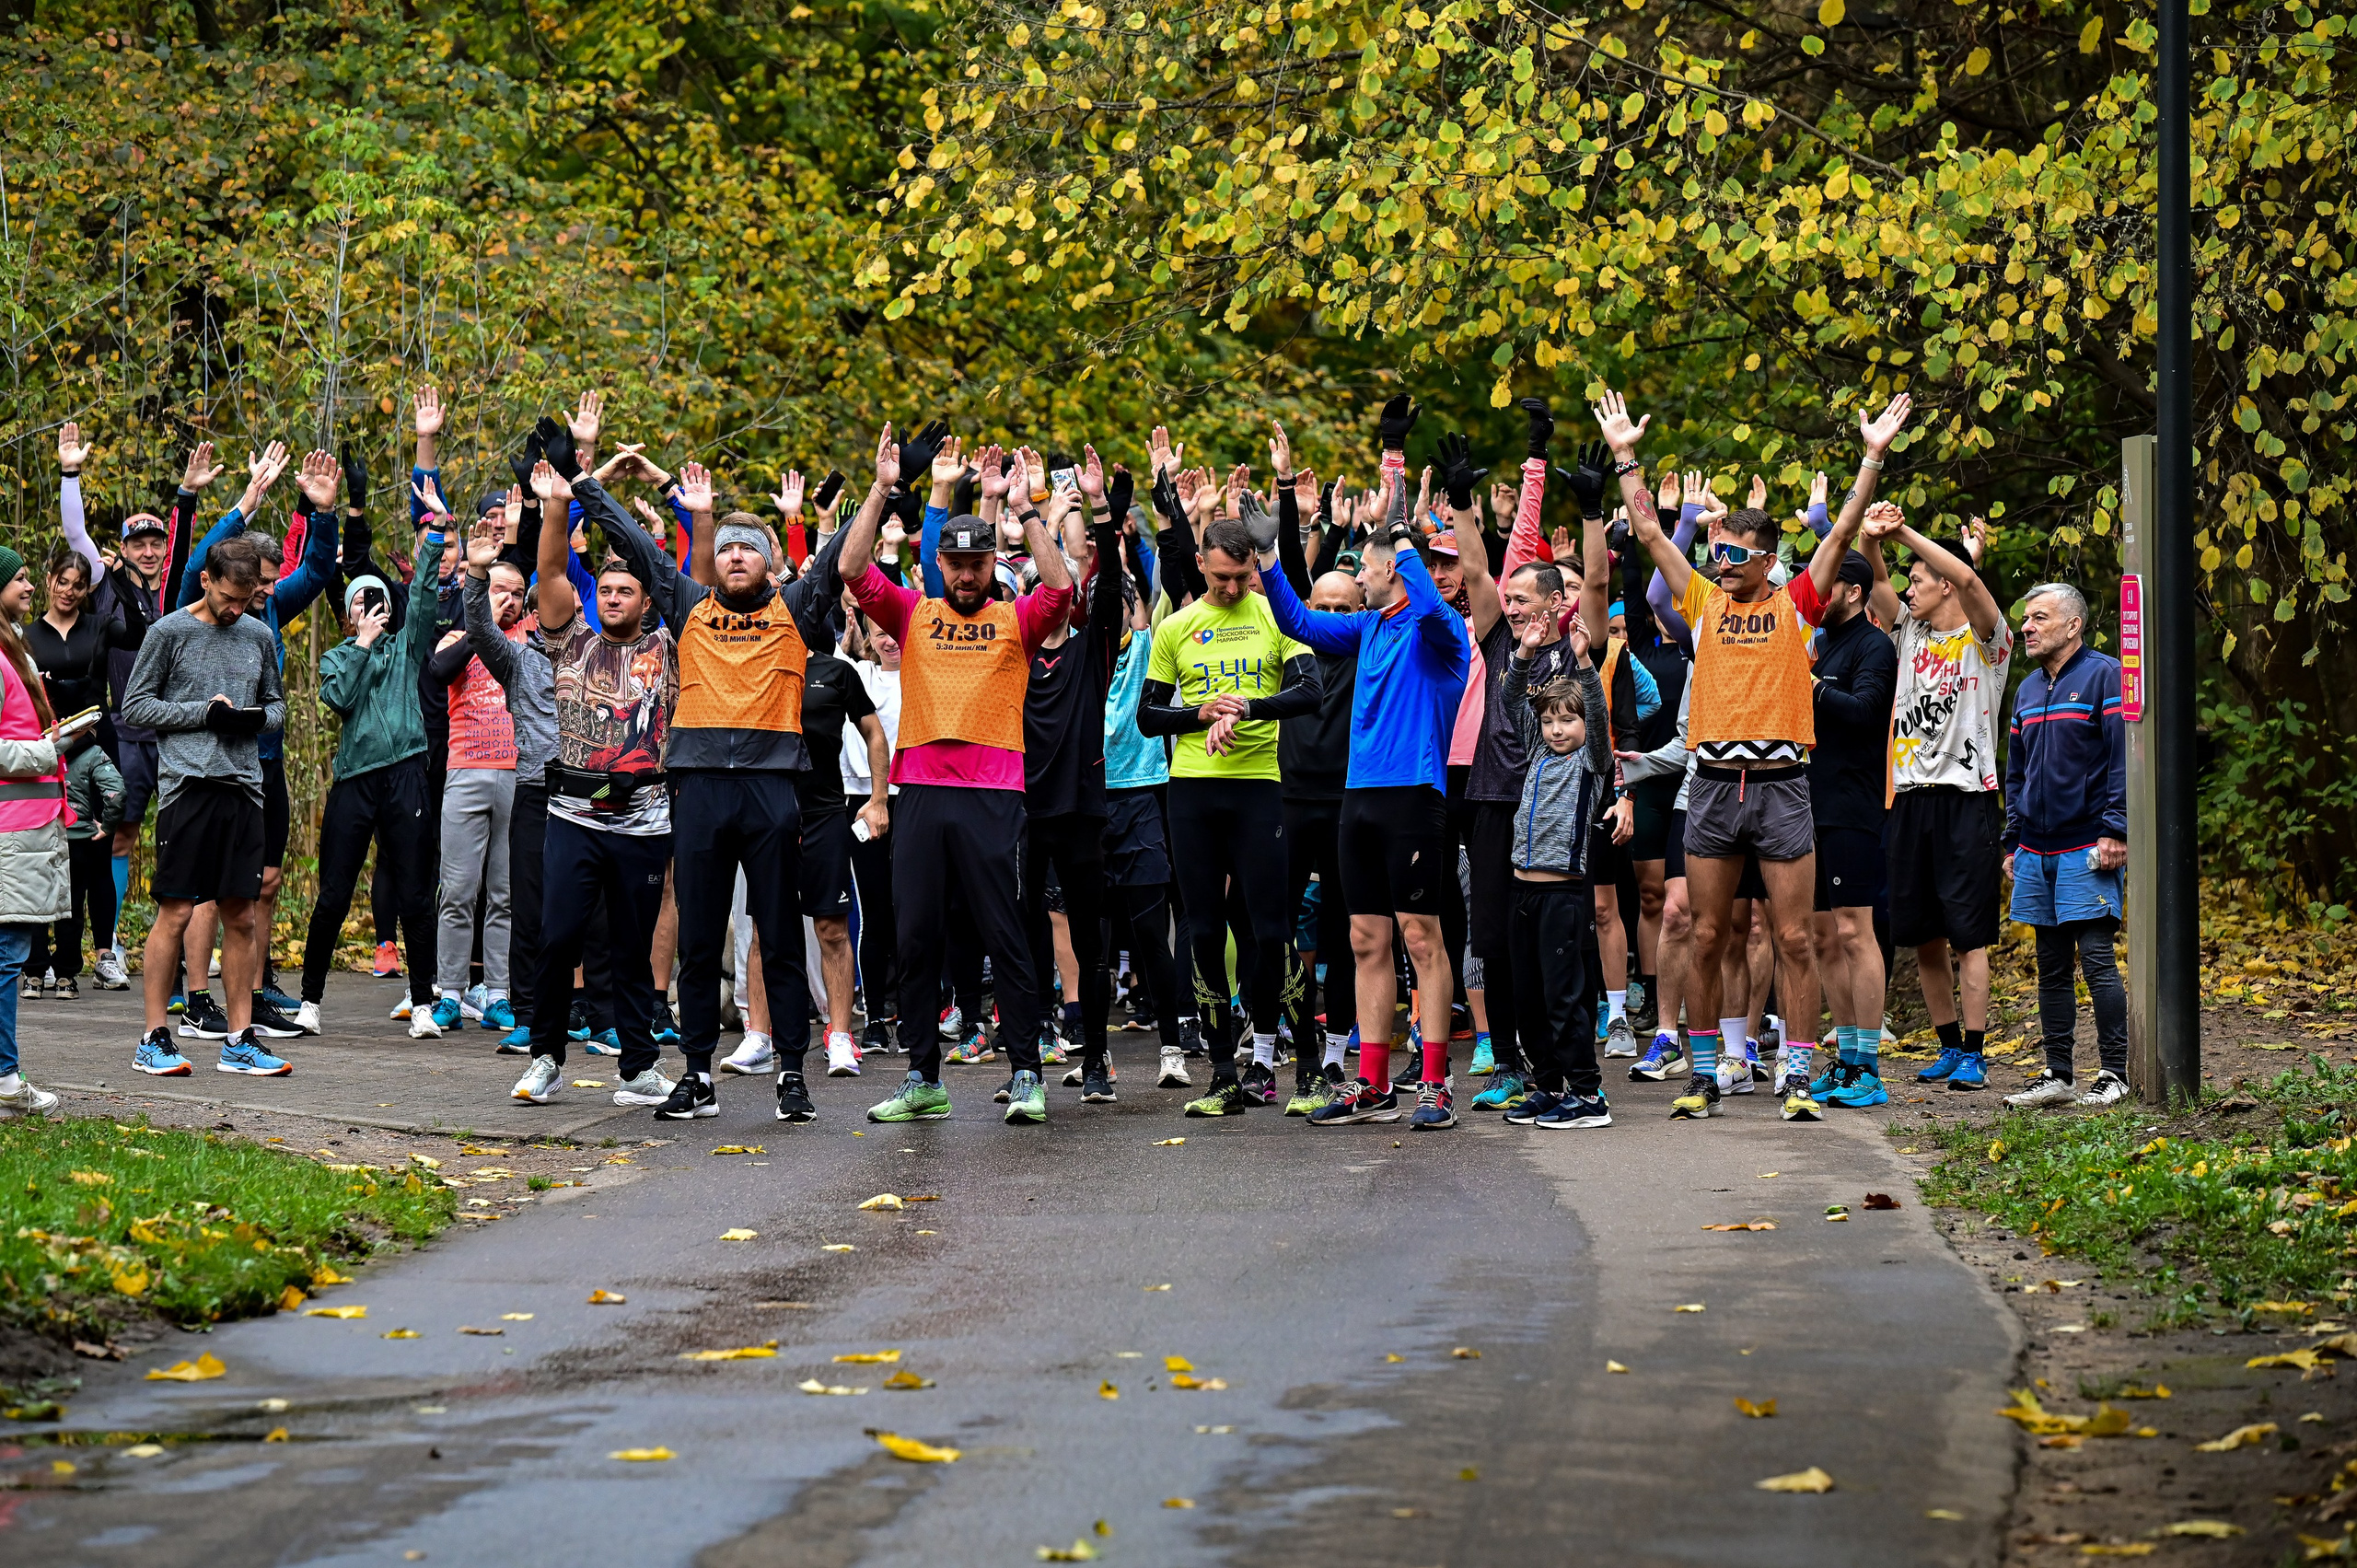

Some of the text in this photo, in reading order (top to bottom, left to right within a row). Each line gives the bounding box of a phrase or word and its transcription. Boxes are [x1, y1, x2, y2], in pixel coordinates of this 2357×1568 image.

[1716, 611, 1777, 635] 20:00
[929, 617, 996, 642] 27:30
[1216, 630, 1260, 638] МОСКОВСКИЙ
[1216, 635, 1248, 644] МАРАФОН
[1721, 636, 1736, 645] 4:00
[935, 643, 954, 651] 5:30
[1192, 657, 1262, 695] 3:44
[648, 874, 662, 882] EA7
